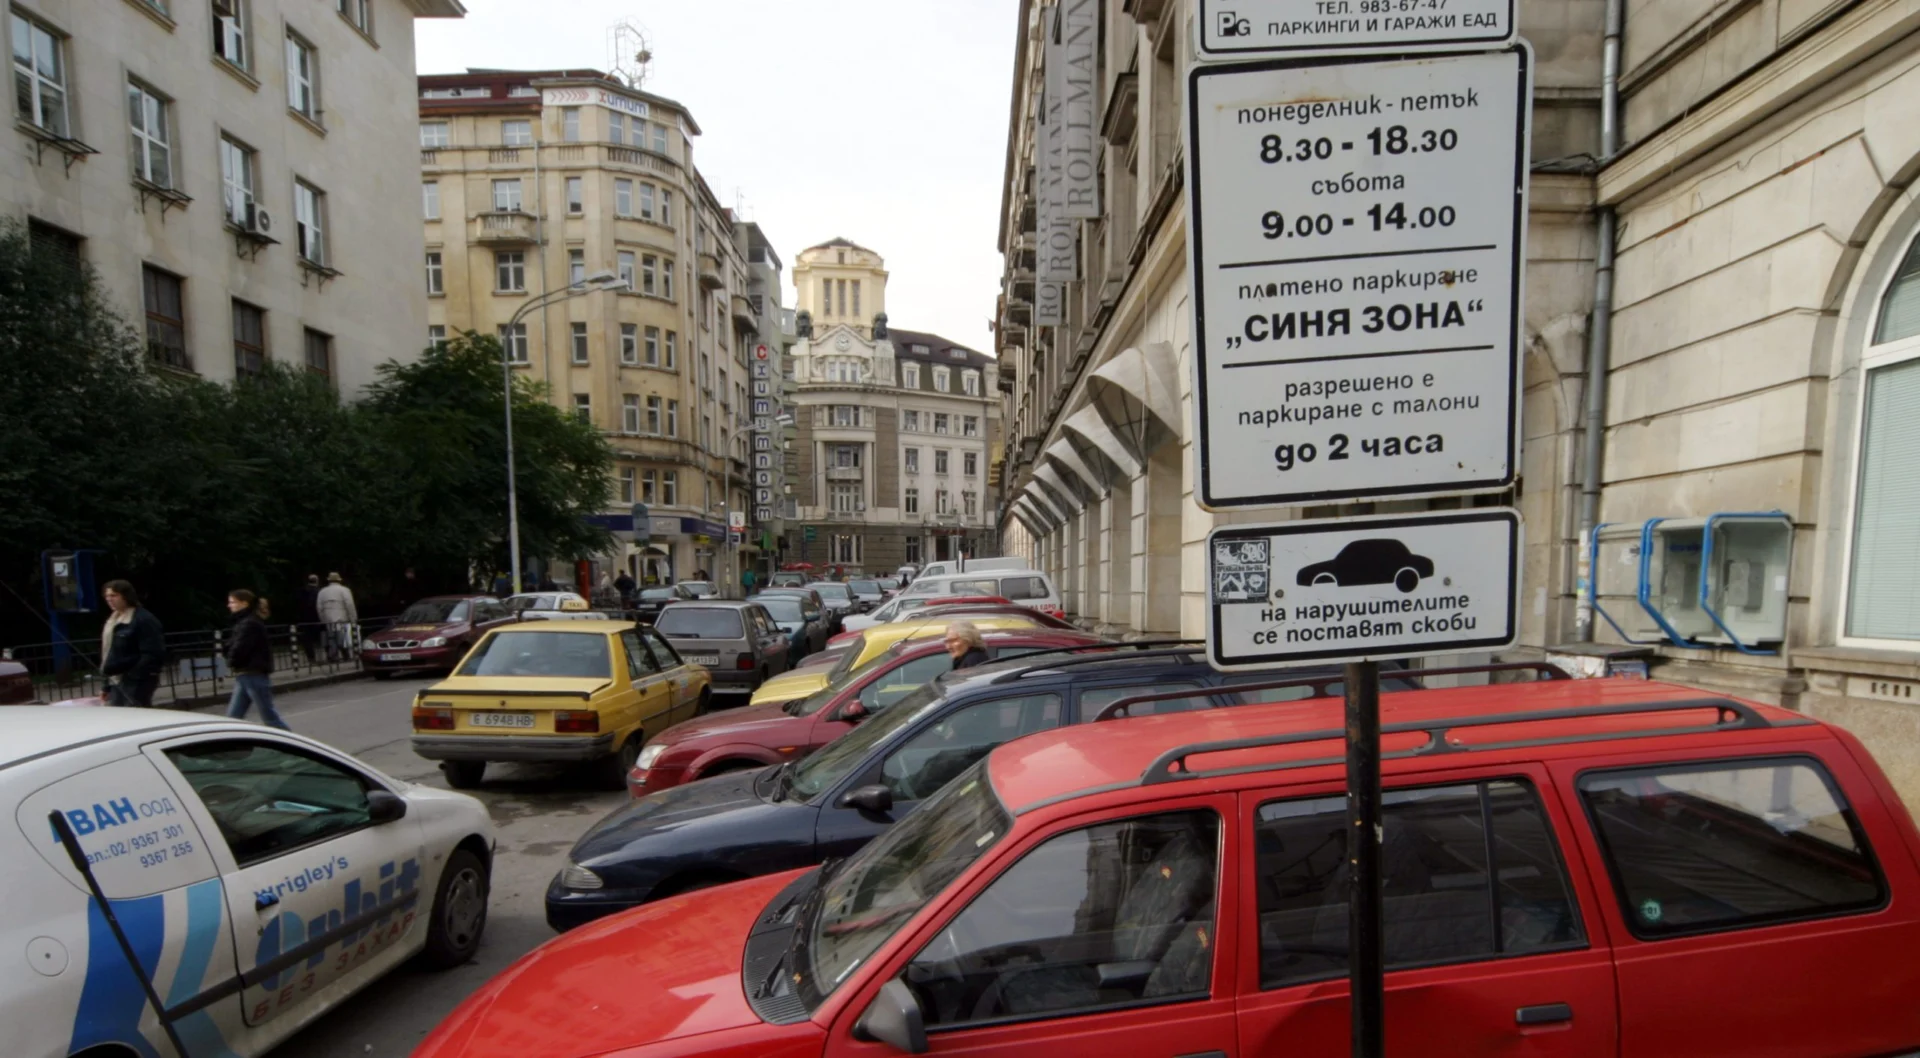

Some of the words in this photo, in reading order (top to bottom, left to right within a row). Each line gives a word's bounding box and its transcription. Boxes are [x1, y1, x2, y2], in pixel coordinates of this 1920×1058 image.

[1268, 17, 1360, 36] ПАРКИНГИ
[1366, 18, 1378, 32] И
[1384, 14, 1457, 31] ГАРАЖИ
[1463, 12, 1497, 28] ЕАД
[1316, 2, 1352, 15] ТЕЛ.
[1360, 0, 1448, 13] 983-67-47
[1067, 0, 1093, 209] ROLLMANN
[1237, 94, 1383, 125] понеделник
[1400, 87, 1479, 112] петък
[1260, 134, 1333, 163] 8.30
[1341, 142, 1354, 151] -
[1366, 125, 1458, 156] 18.30
[1311, 172, 1405, 196] събота
[1261, 210, 1334, 240] 9.00
[1342, 218, 1354, 226] -
[1367, 202, 1456, 232] 14.00
[1239, 278, 1343, 299] платено
[1353, 268, 1478, 294] паркиране
[1226, 308, 1351, 349] „СИНЯ
[1362, 299, 1483, 334] ЗОНА“
[1284, 374, 1414, 402] разрешено
[1422, 373, 1434, 388] е
[1238, 403, 1363, 427] паркиране
[1371, 401, 1384, 416] с
[1393, 395, 1480, 415] талони
[1274, 442, 1317, 471] до
[1328, 433, 1350, 461] 2
[1361, 433, 1444, 459] часа
[1261, 607, 1286, 622] на
[1295, 594, 1470, 622] нарушителите
[1253, 630, 1278, 645] се
[1286, 619, 1404, 643] поставят
[1411, 612, 1477, 635] скоби
[484, 713, 514, 726] 6948
[49, 797, 139, 843] ВАН
[86, 831, 160, 865] ел.:02/9367
[162, 824, 184, 841] 301
[140, 849, 168, 868] 9367
[173, 841, 193, 858] 255
[253, 856, 348, 902] Wrigley's
[251, 973, 315, 1022] БЕЗ
[336, 911, 416, 971] ЗАХАР
